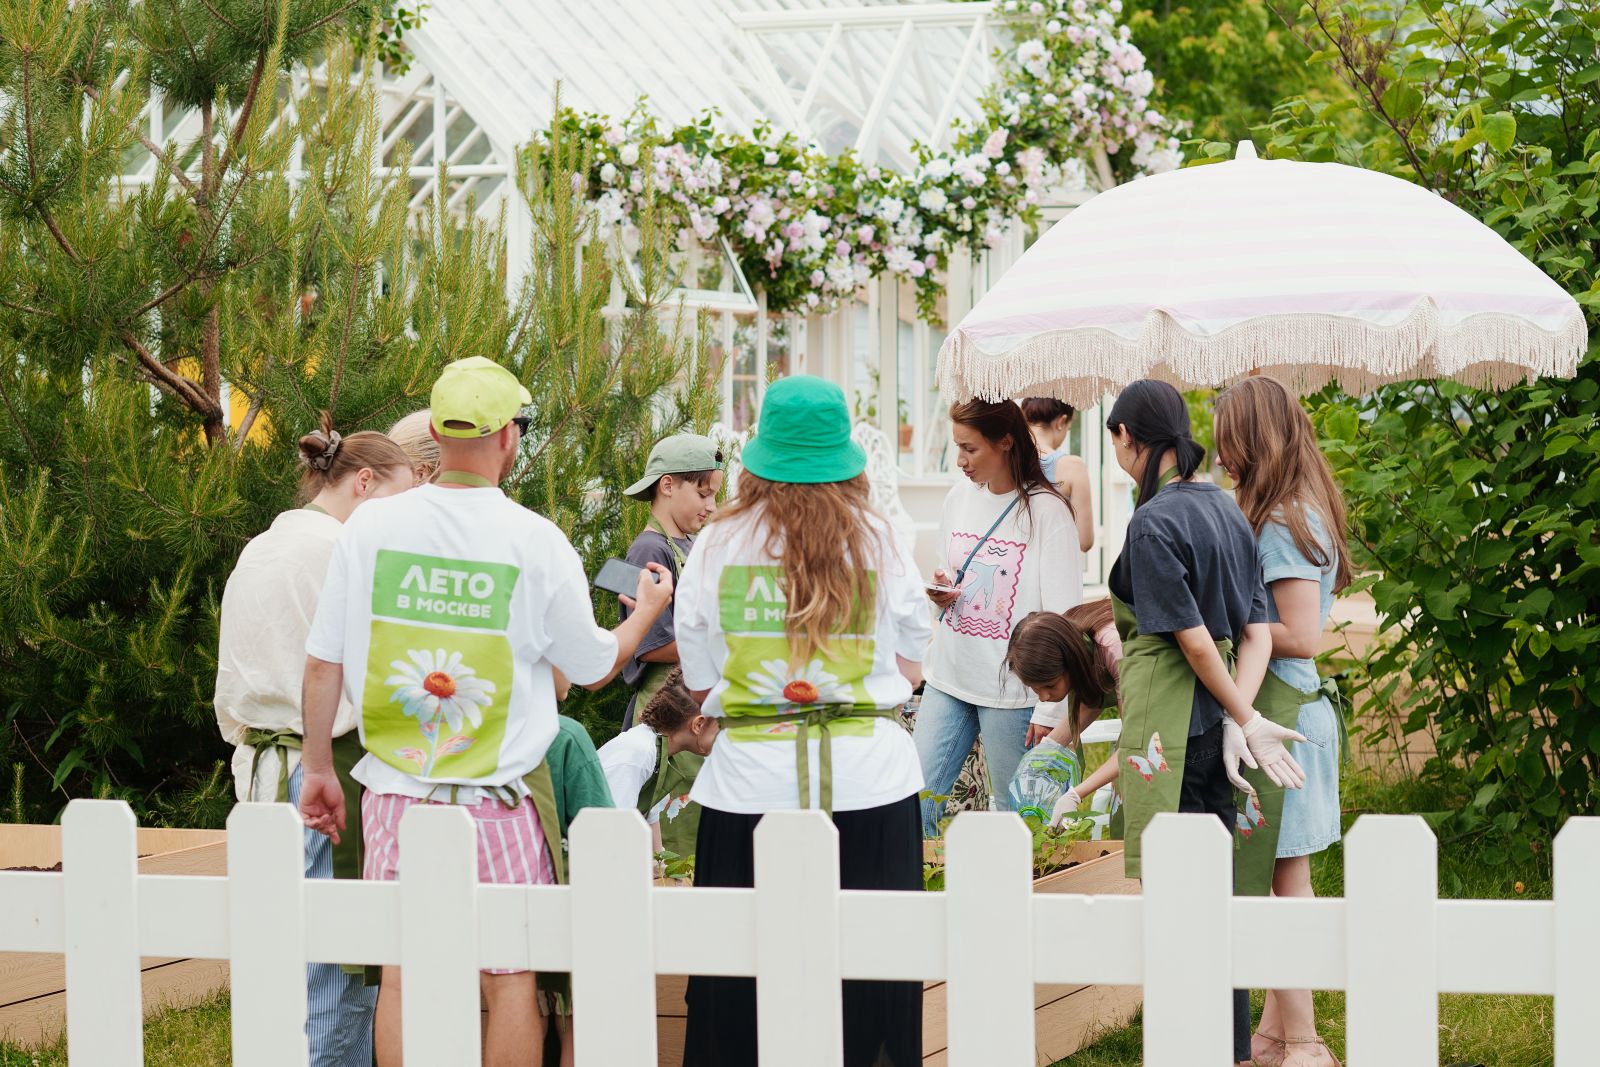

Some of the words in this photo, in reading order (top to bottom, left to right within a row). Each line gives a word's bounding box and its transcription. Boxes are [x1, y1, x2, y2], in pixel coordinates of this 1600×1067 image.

[400, 564, 495, 599] ЛЕТО
[396, 594, 410, 609] В
[416, 598, 492, 618] МОСКВЕ
[744, 608, 757, 621] В
